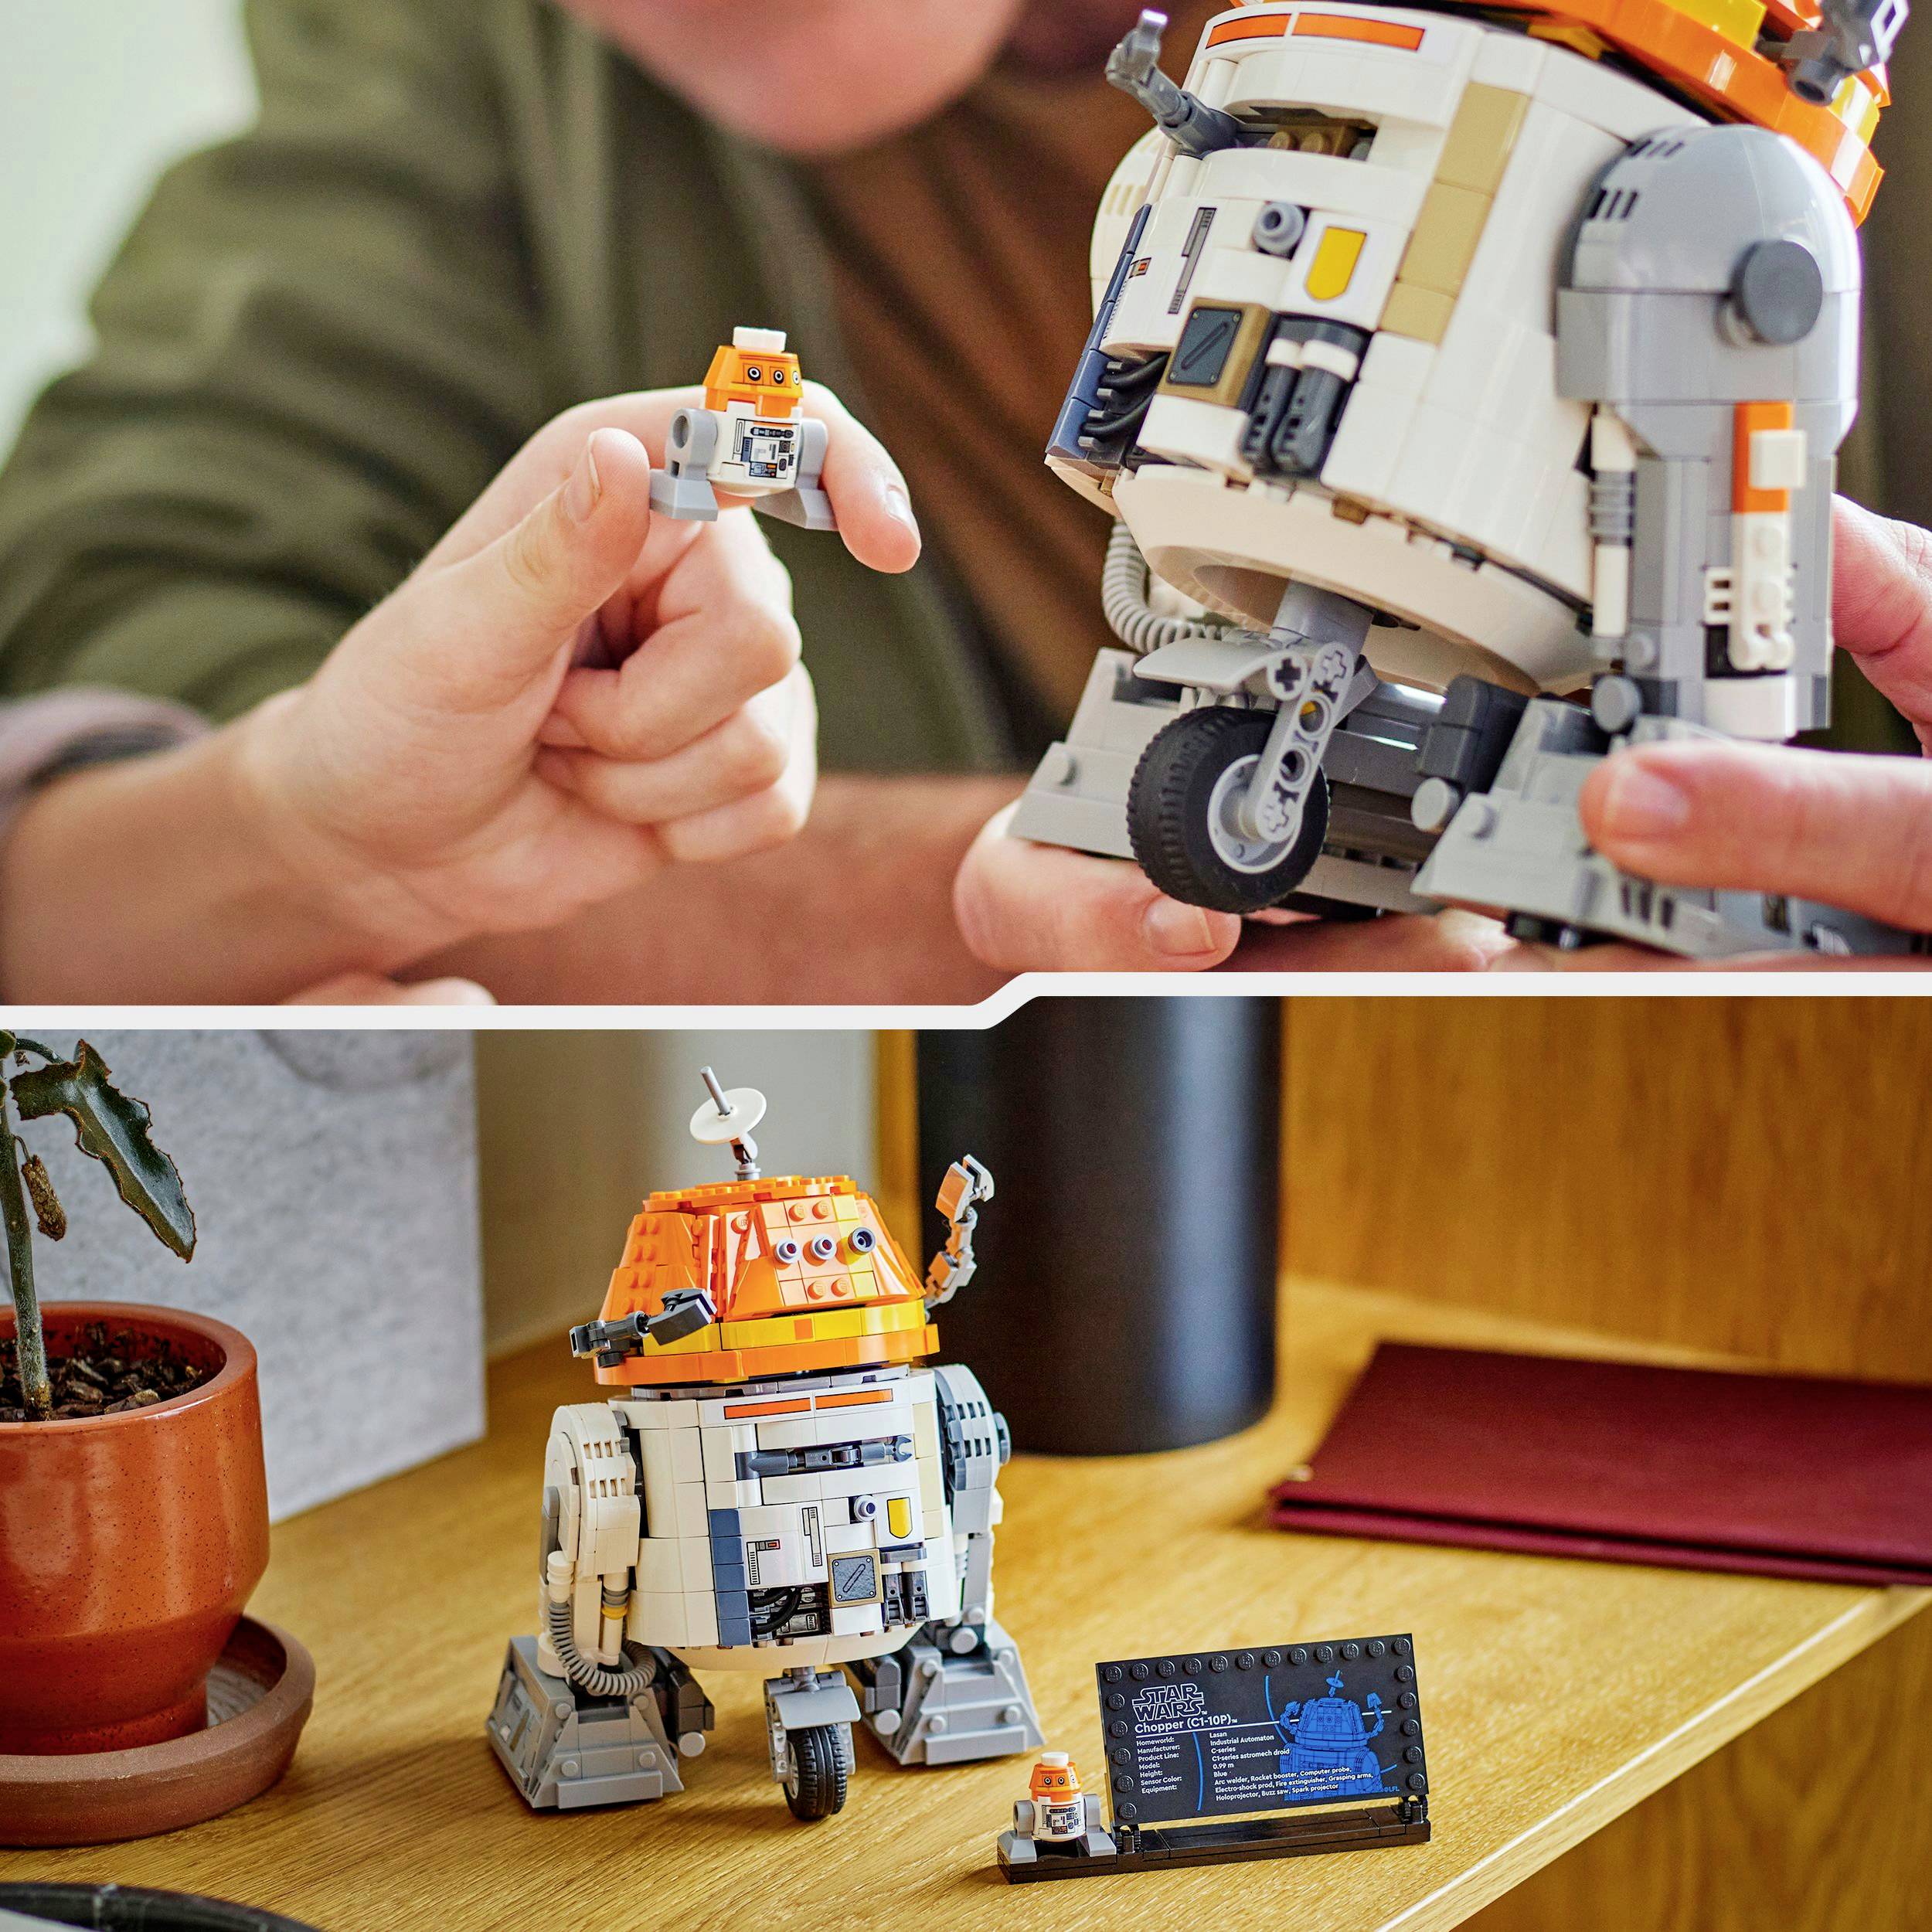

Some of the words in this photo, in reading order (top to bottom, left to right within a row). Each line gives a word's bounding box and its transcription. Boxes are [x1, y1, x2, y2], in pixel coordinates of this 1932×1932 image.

[1132, 1683, 1204, 1706] STAR
[1134, 1720, 1184, 1733] Chopper
[1136, 1736, 1175, 1746] Homeworld:
[1210, 1737, 1239, 1746] Industrial
[1240, 1735, 1274, 1743] Automaton
[1137, 1745, 1181, 1754] Manufacturer:
[1240, 1750, 1272, 1759] astromech
[1300, 1768, 1331, 1777] Computer
[1141, 1784, 1177, 1794] Equipment:
[1215, 1783, 1257, 1793] Electro-shock
[1258, 1781, 1274, 1790] prod,
[1288, 1777, 1327, 1785] extinguisher,
[1216, 1791, 1260, 1801] Holoprojector,
[1291, 1785, 1309, 1794] Spark
